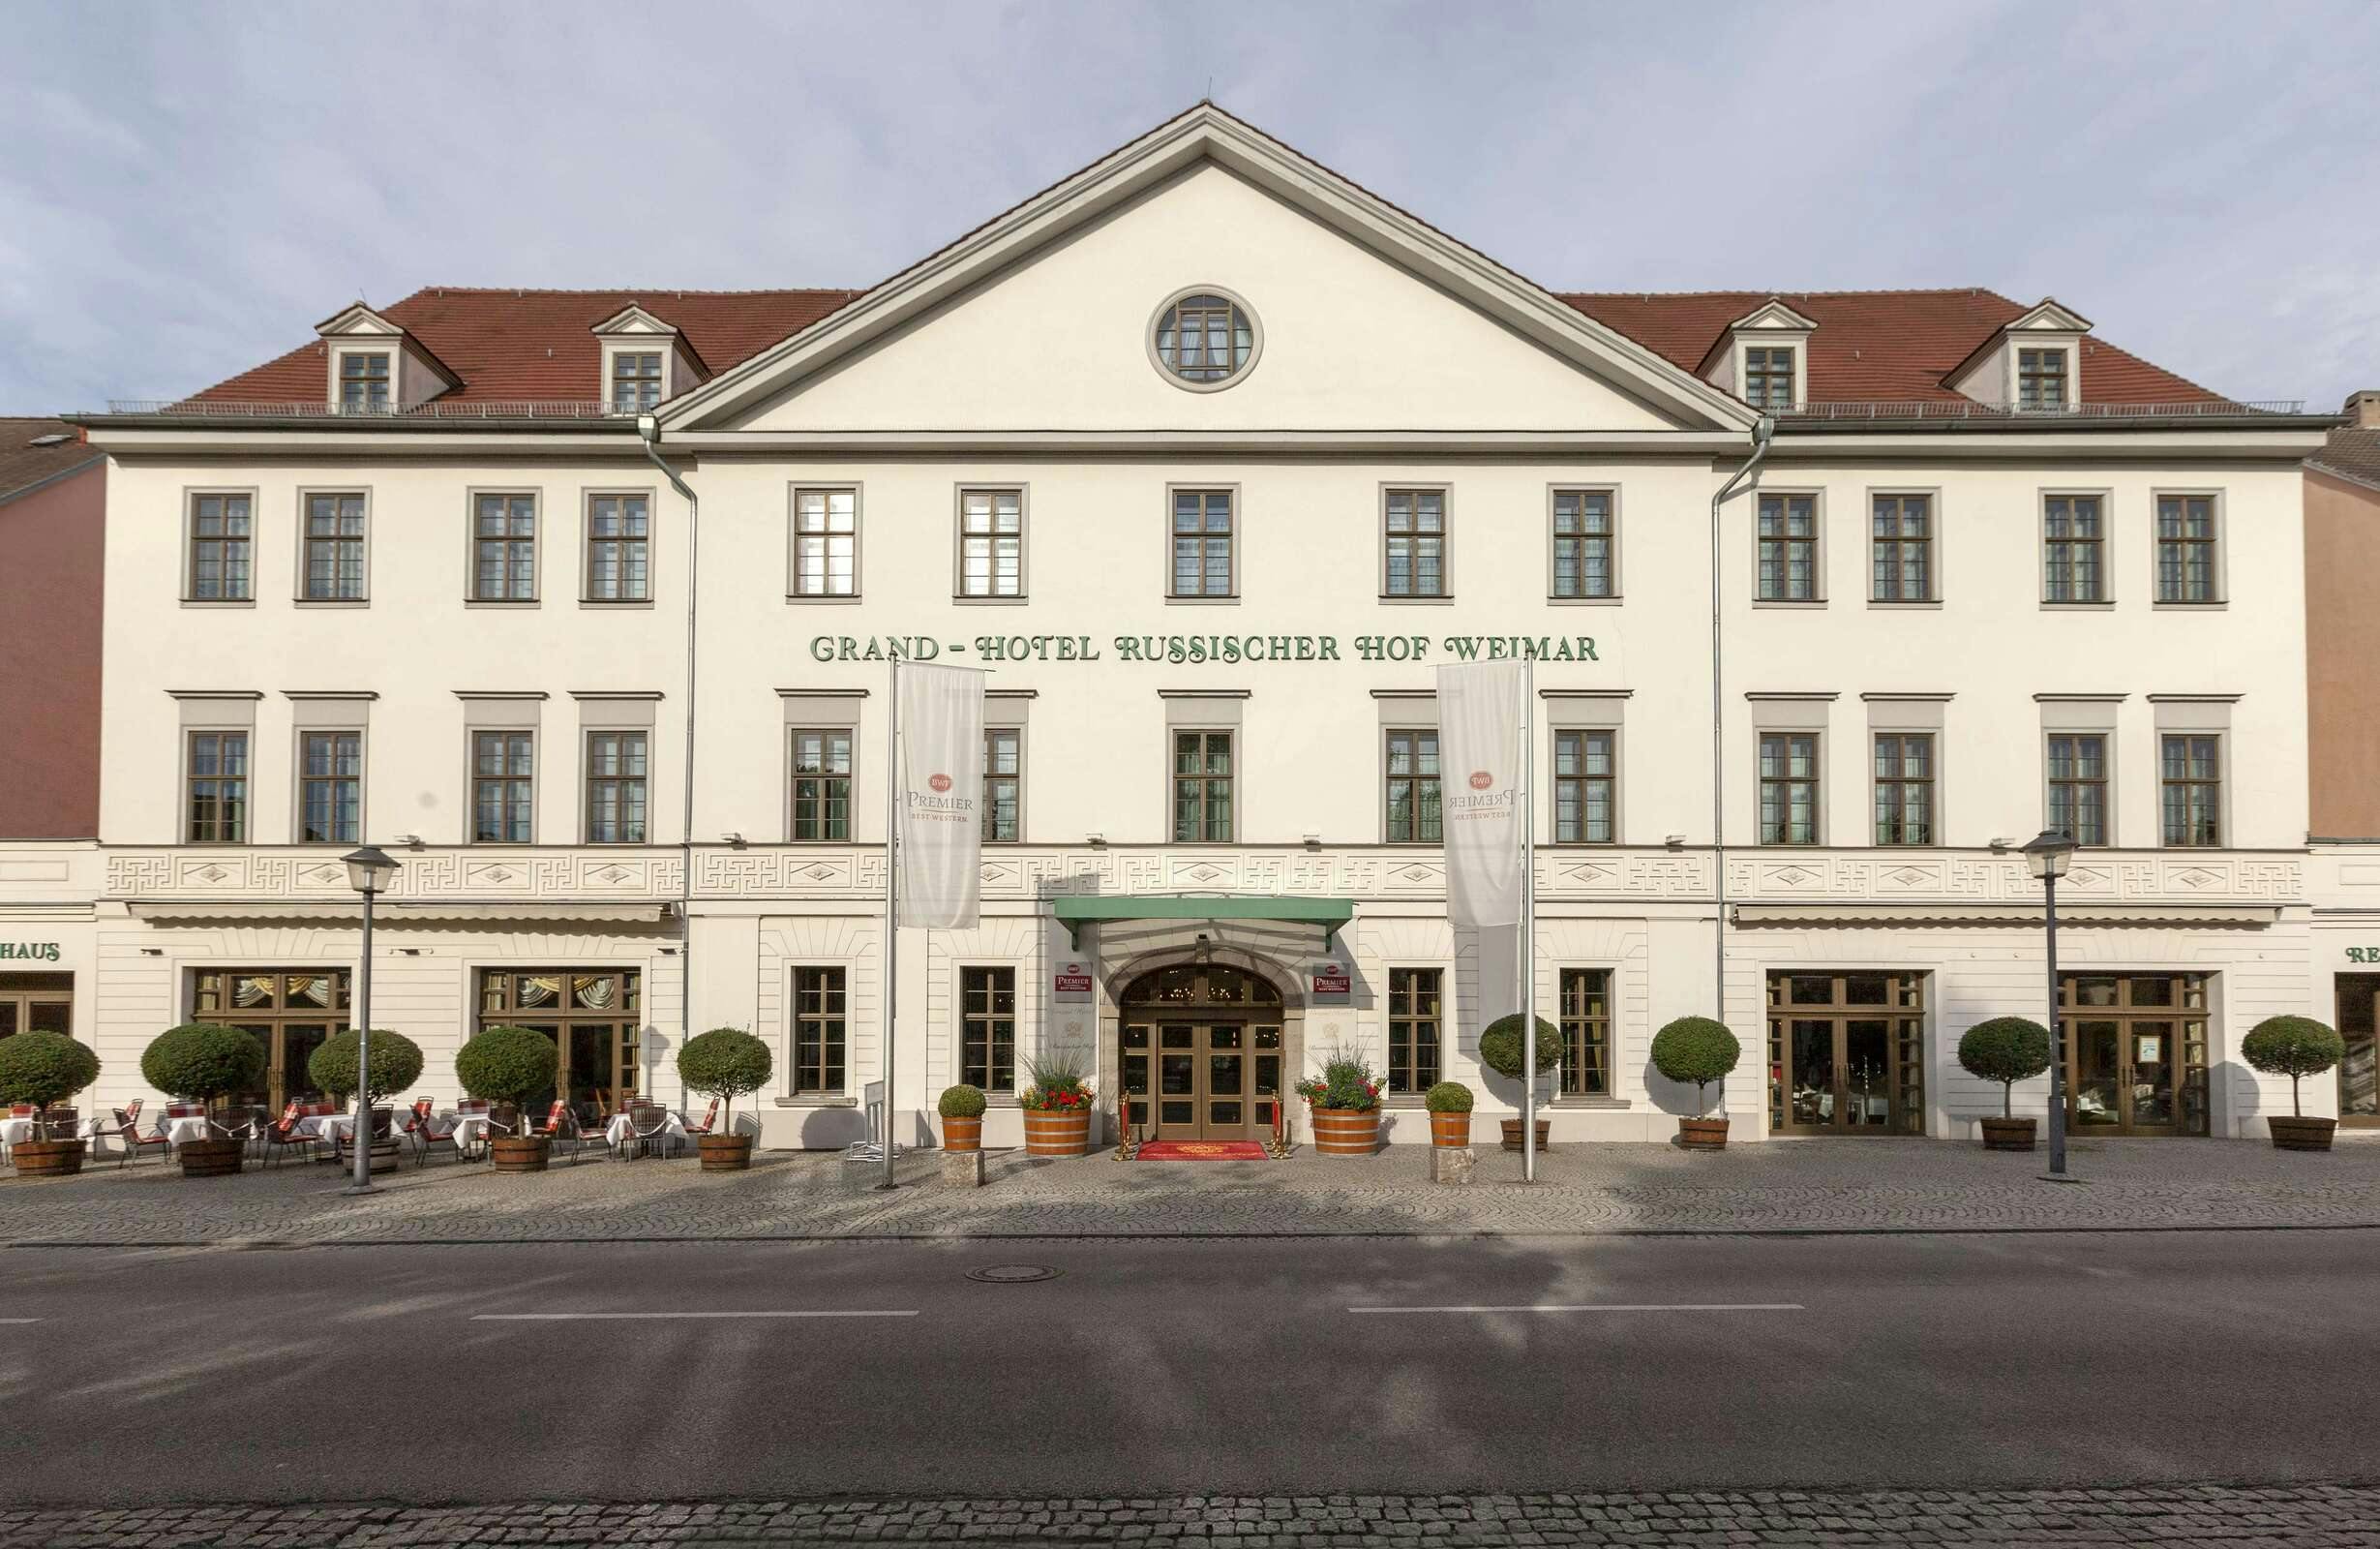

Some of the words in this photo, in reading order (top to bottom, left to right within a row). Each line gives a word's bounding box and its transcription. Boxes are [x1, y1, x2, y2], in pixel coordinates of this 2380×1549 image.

[810, 635, 939, 661] GRAND
[975, 635, 1100, 661] HOTEL
[1115, 635, 1340, 664] RUSSISCHER
[1355, 635, 1431, 661] HOF
[1444, 636, 1599, 661] WEIMAR
[906, 790, 974, 810] PREMIER
[0, 942, 60, 961] HAUS
[1057, 976, 1090, 985] PREMIER
[1316, 977, 1348, 987] PREMIER
